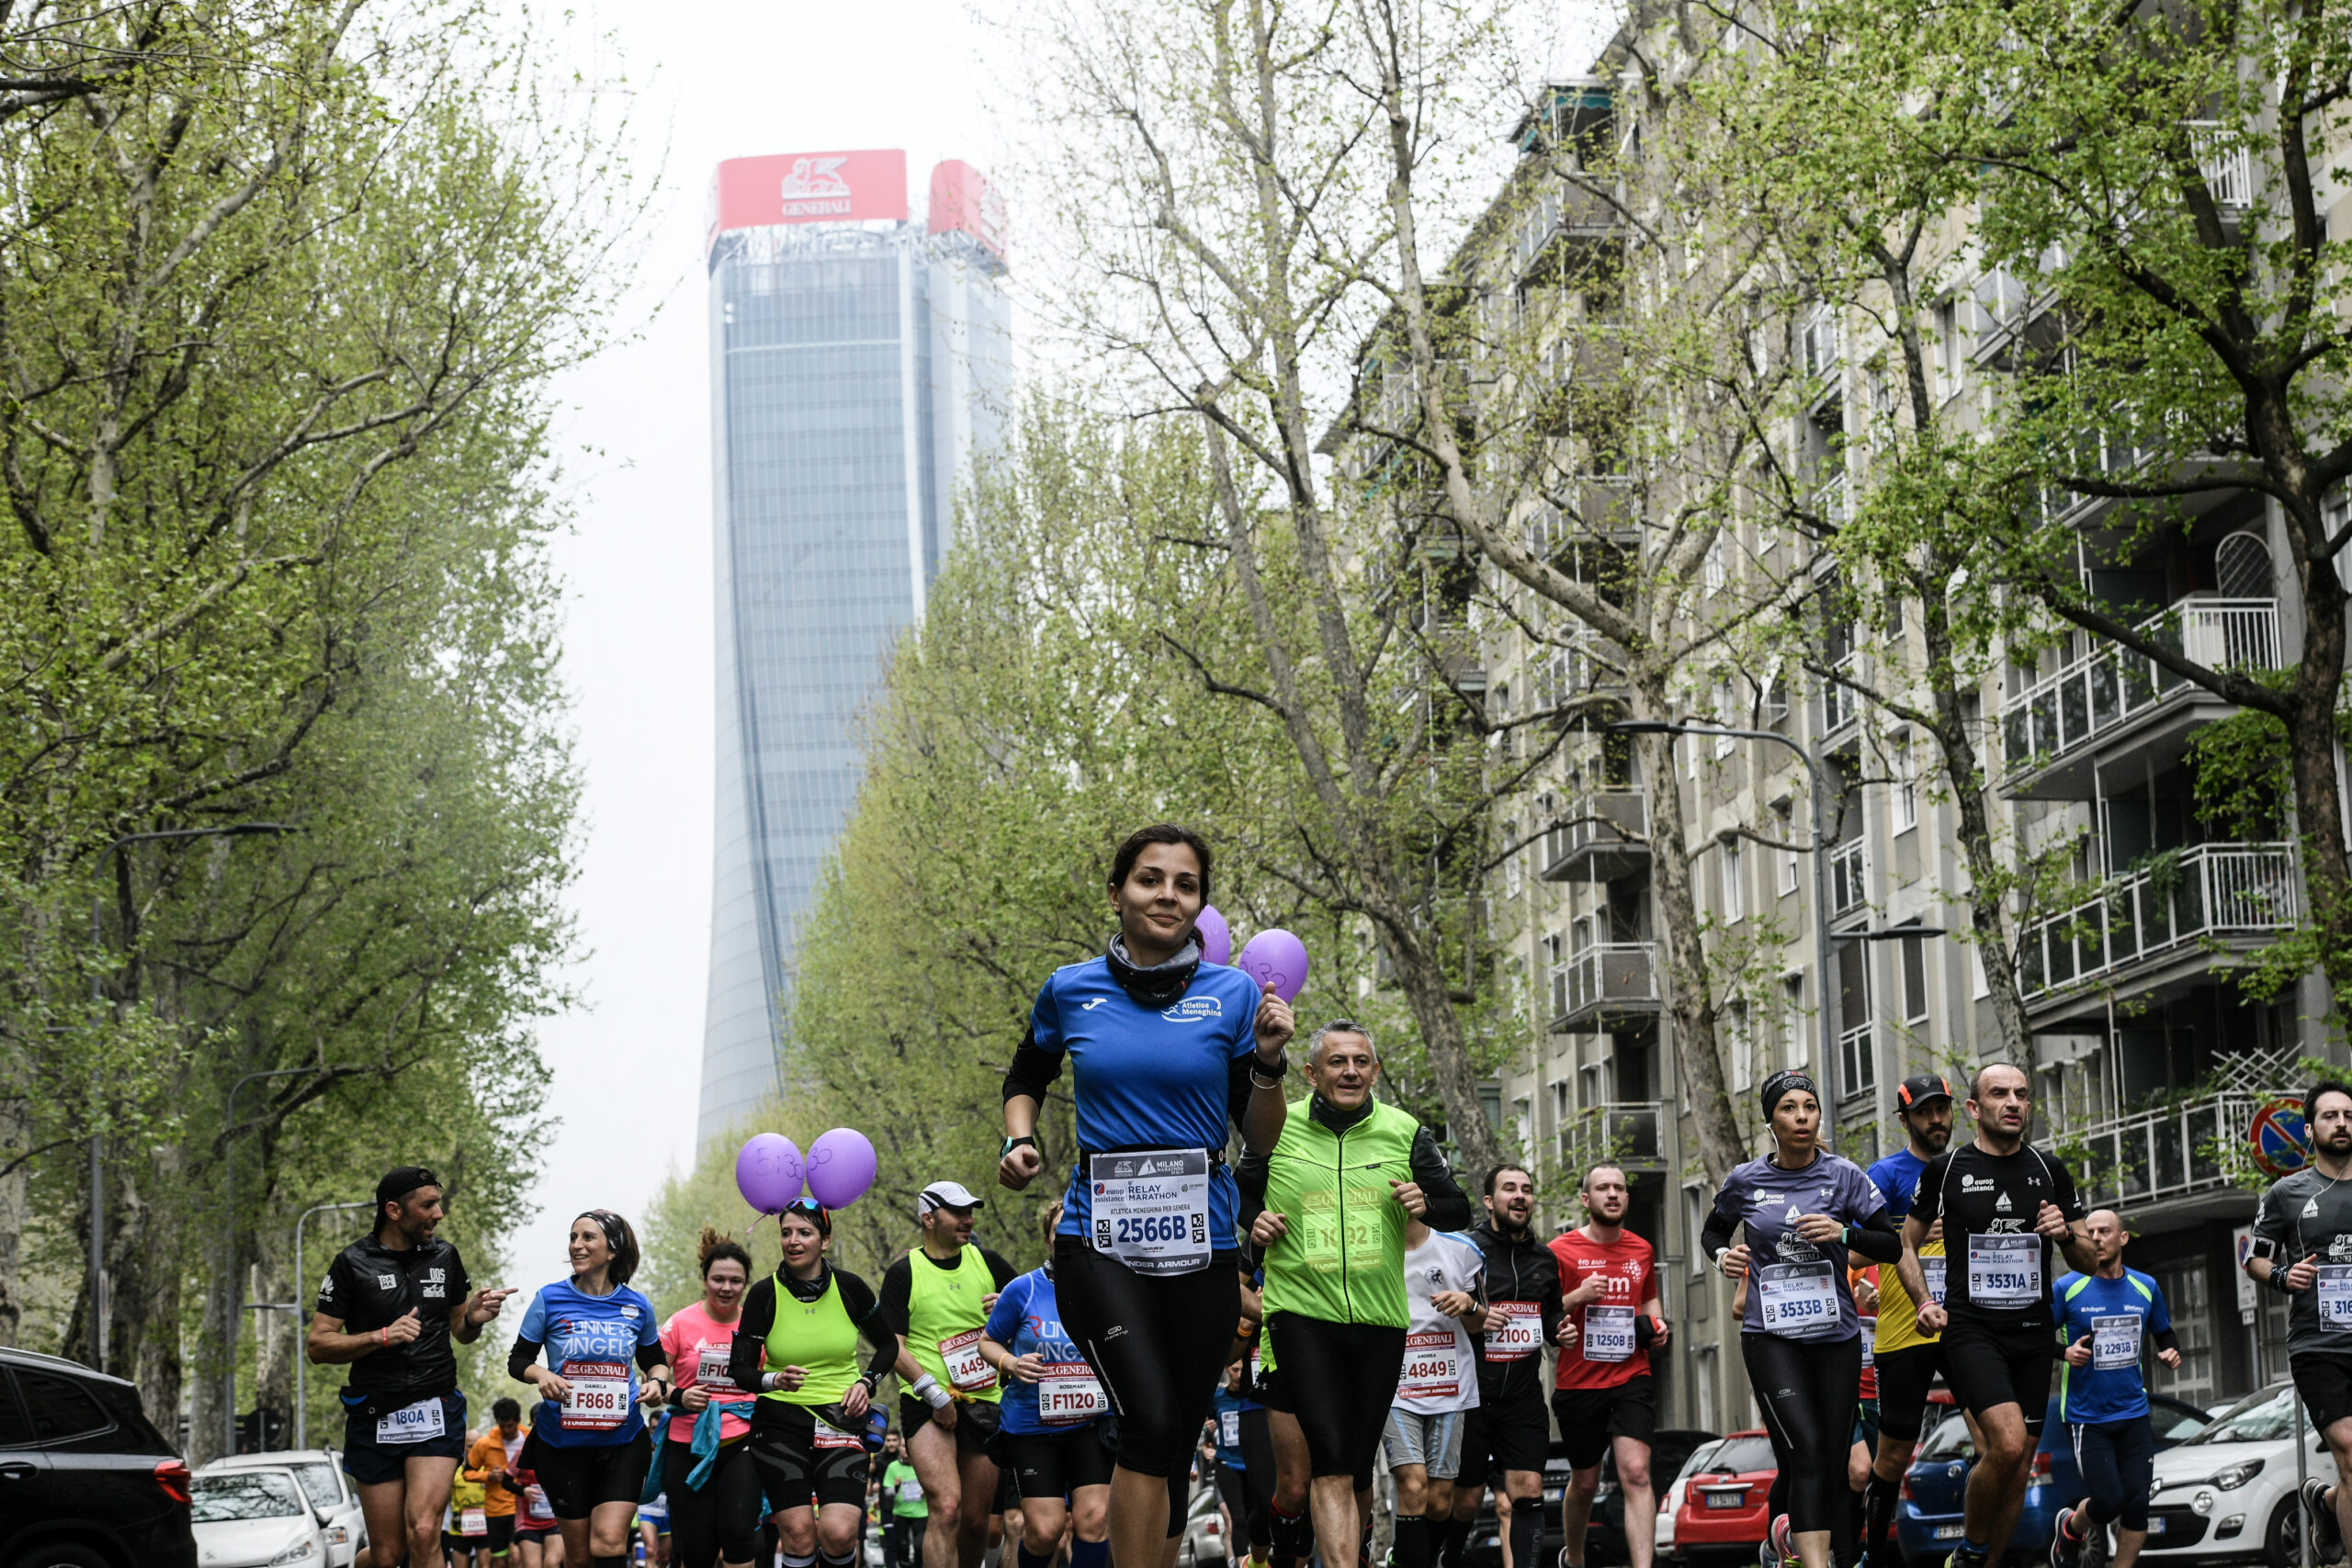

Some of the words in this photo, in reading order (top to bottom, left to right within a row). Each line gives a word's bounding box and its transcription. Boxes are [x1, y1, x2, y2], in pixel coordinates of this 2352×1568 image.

[782, 199, 851, 217] GENERALI
[1182, 1009, 1222, 1017] Meneghina
[1128, 1185, 1161, 1194] RELAY
[1962, 1185, 1995, 1193] assistance
[1094, 1195, 1125, 1203] assistance
[1128, 1192, 1177, 1201] MARATHON
[1322, 1191, 1378, 1204] GERALI
[1133, 1205, 1162, 1213] MENEGHINA
[1755, 1199, 1784, 1207] assistance
[1117, 1215, 1187, 1243] 2566B
[1158, 1258, 1200, 1268] ARMOUR
[429, 1268, 446, 1280] DDS
[1986, 1273, 2027, 1289] 3531A
[1499, 1303, 1538, 1314] GENERALI
[1780, 1299, 1823, 1317] 3533B
[1409, 1334, 1453, 1346] GENERALI
[1496, 1328, 1531, 1343] 2100
[1596, 1334, 1625, 1347] 1250B
[561, 1336, 638, 1358] ANGELS
[2105, 1341, 2132, 1355] 2293B
[580, 1364, 626, 1376] GENERALI
[1056, 1365, 1095, 1375] GENERA
[1408, 1361, 1447, 1379] 4849
[577, 1393, 614, 1409] F868
[1053, 1393, 1094, 1411] F1120
[394, 1410, 425, 1426] 180A
